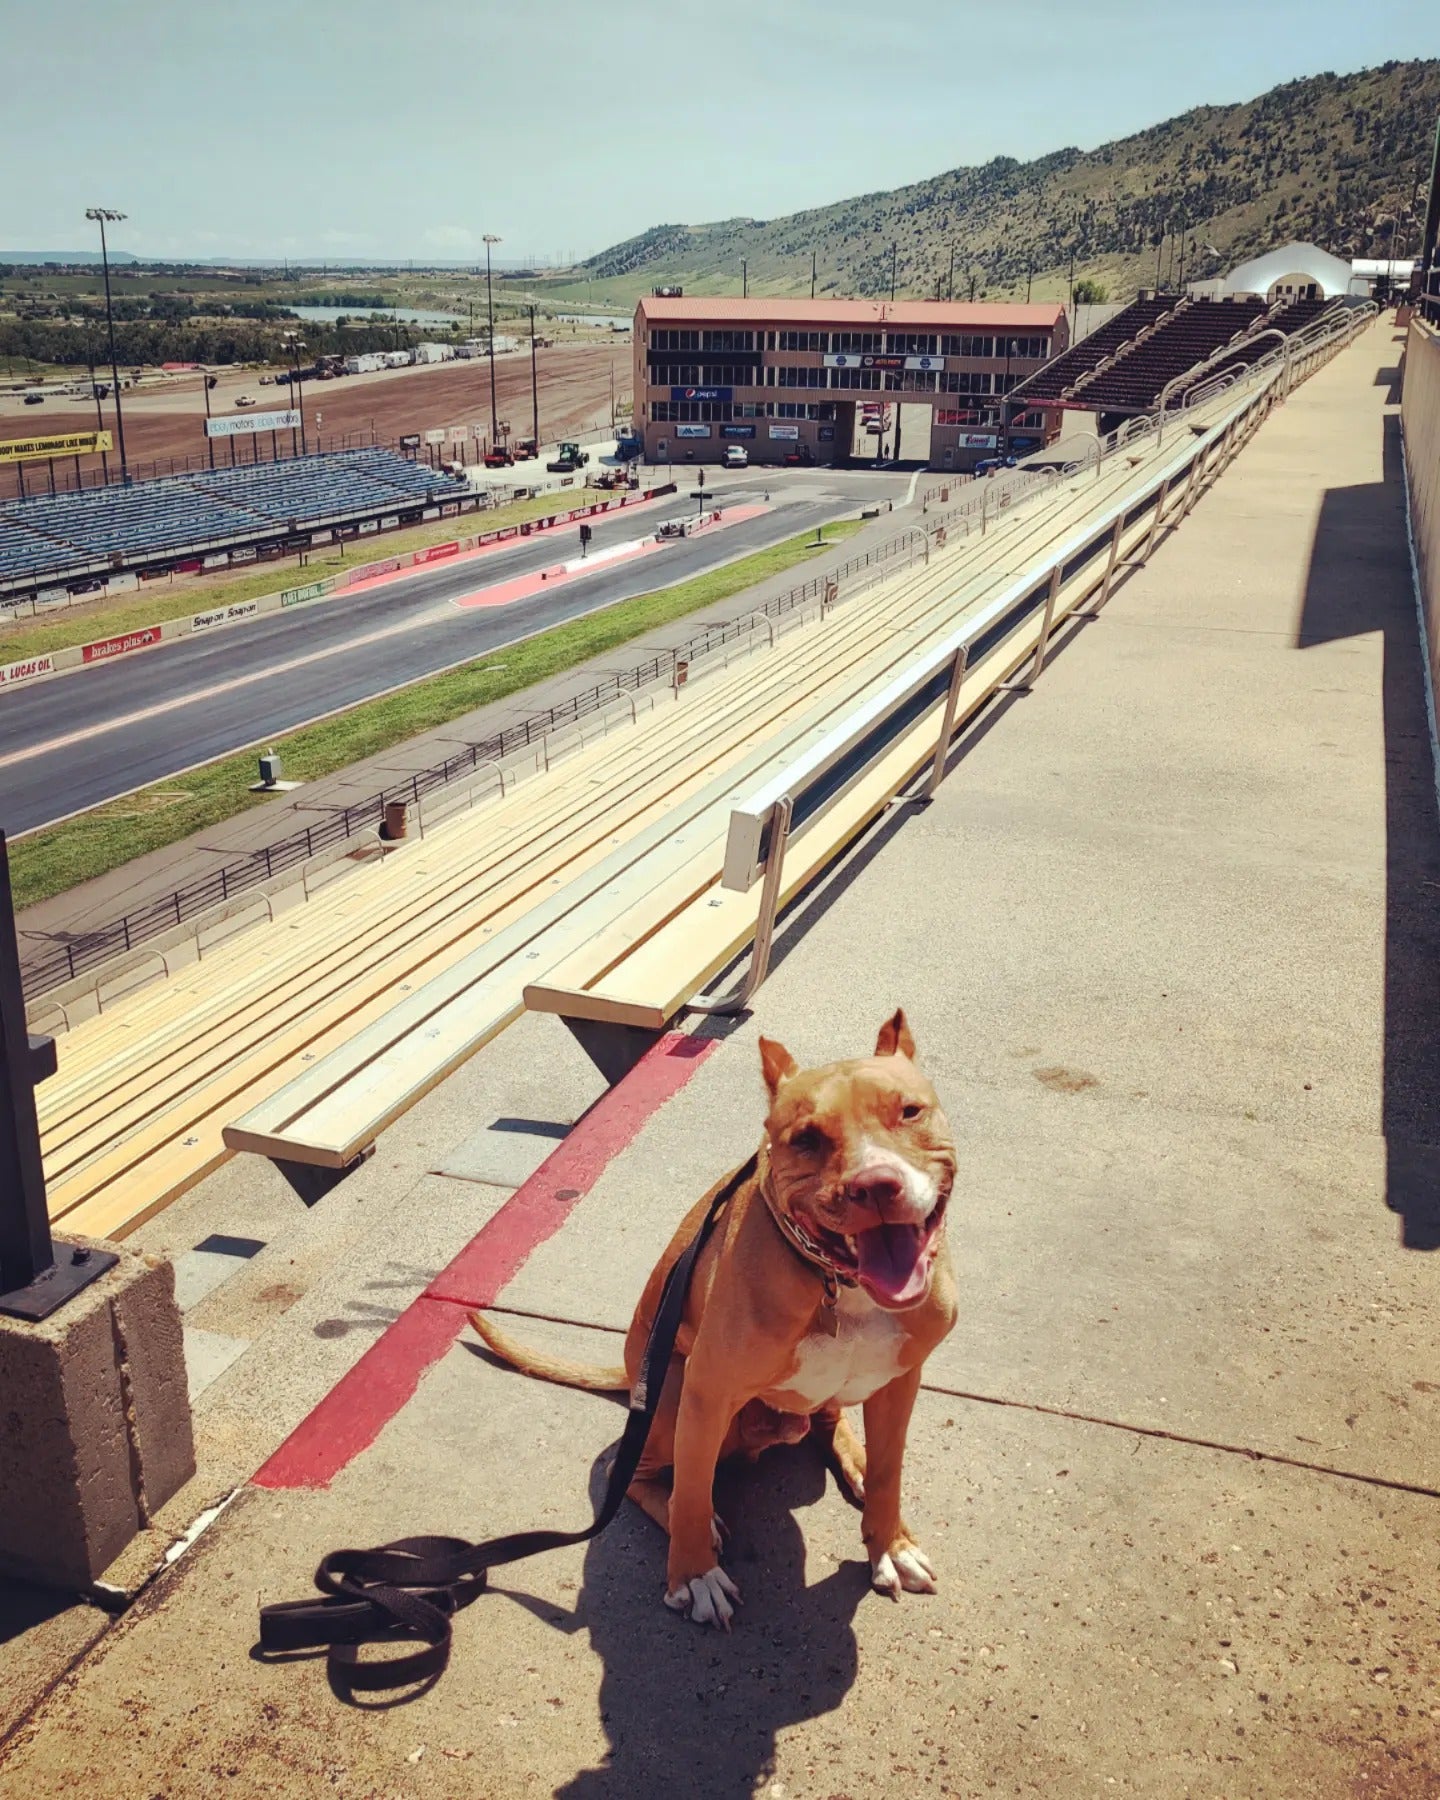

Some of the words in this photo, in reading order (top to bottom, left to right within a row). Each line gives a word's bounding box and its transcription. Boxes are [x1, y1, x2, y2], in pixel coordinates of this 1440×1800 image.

[91, 641, 121, 658] brakes
[123, 636, 142, 651] plus
[10, 661, 36, 679] LUCAS
[38, 658, 51, 671] OIL
